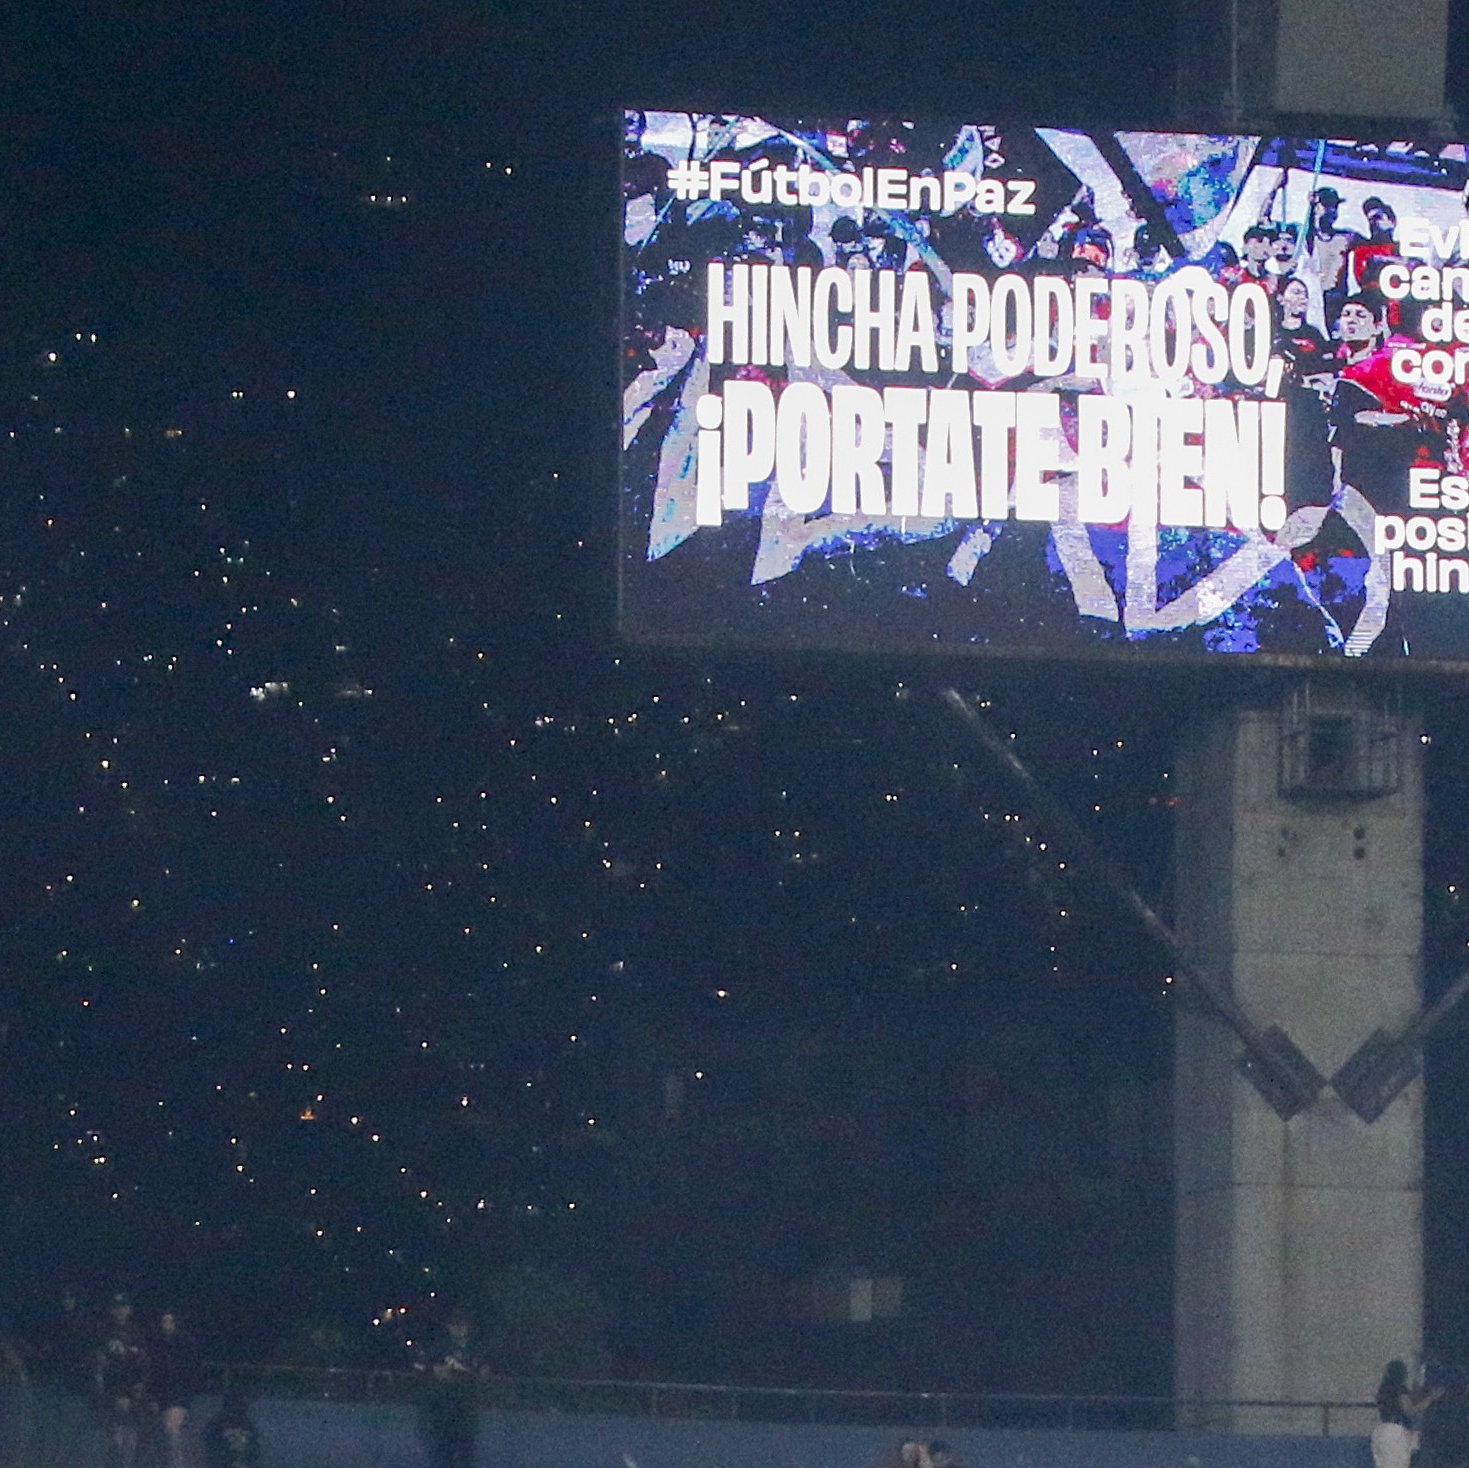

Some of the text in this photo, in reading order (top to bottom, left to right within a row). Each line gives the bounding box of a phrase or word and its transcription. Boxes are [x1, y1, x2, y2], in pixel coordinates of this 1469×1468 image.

[666, 158, 1037, 216] #FútbolEnPaz
[706, 262, 1285, 398] HINCHA PODEROSO,
[696, 381, 1287, 530] ¡PORTATE BIEN!
